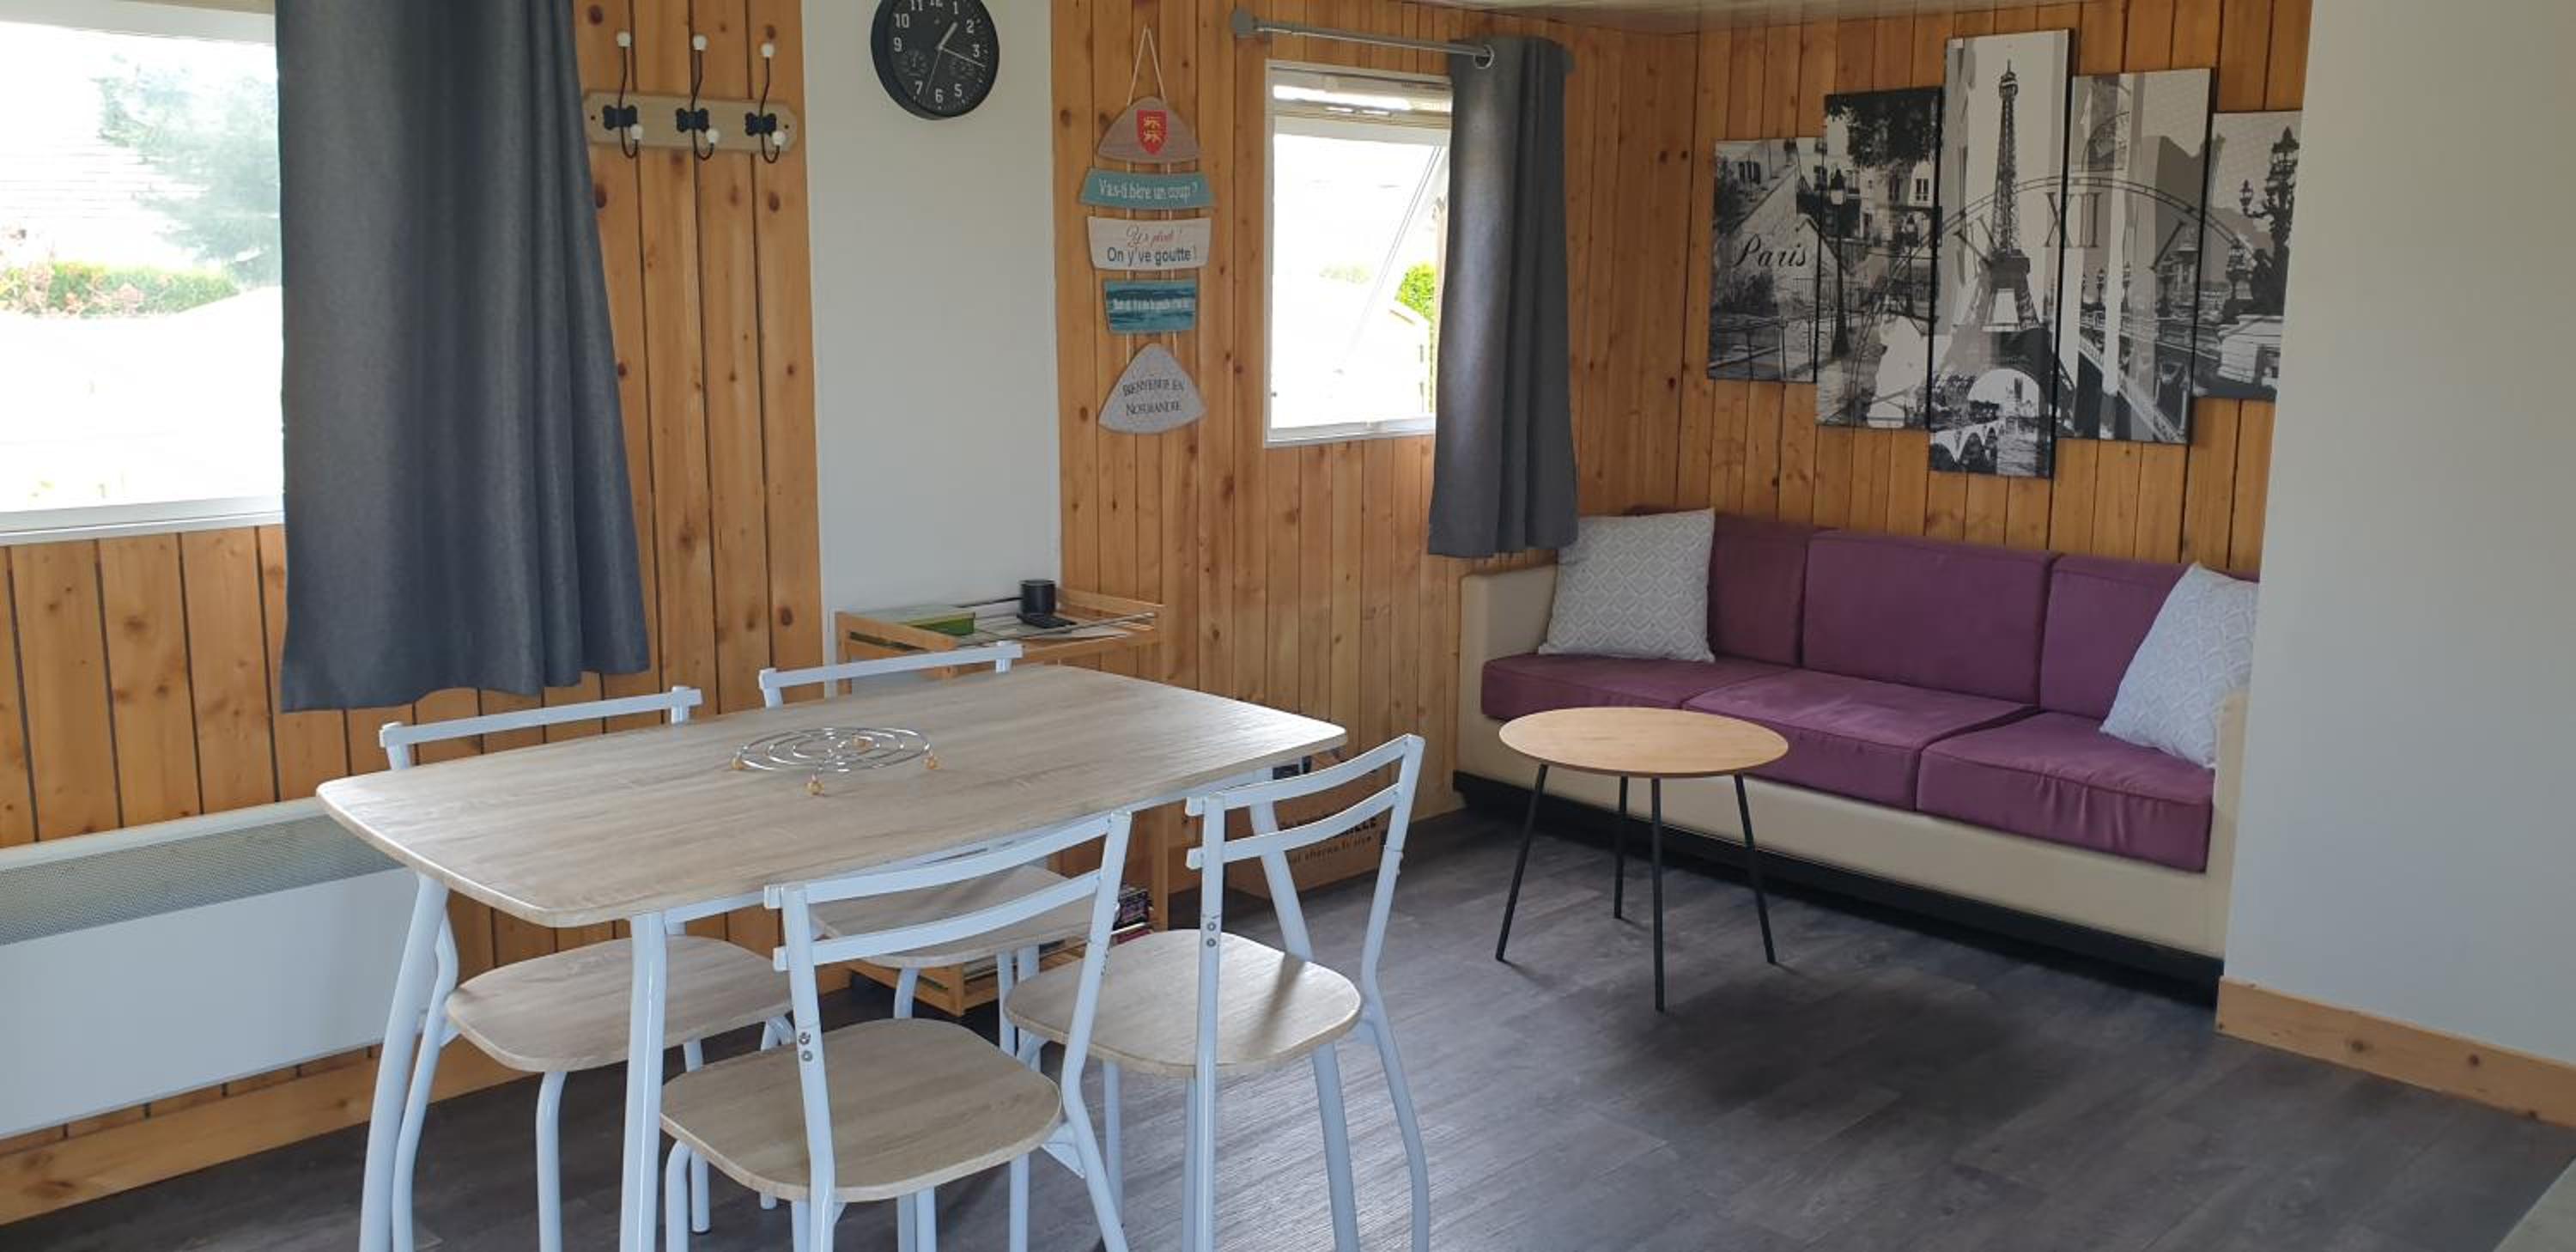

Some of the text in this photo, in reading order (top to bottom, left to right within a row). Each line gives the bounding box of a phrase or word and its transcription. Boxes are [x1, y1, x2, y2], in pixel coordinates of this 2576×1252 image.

[894, 13, 910, 28] 10
[966, 19, 975, 33] 2
[893, 37, 902, 52] 9
[972, 44, 981, 58] 3
[915, 80, 923, 95] 7
[954, 83, 963, 97] 5
[935, 88, 944, 104] 6
[1107, 246, 1124, 262] On
[1732, 233, 1806, 268] Paris
